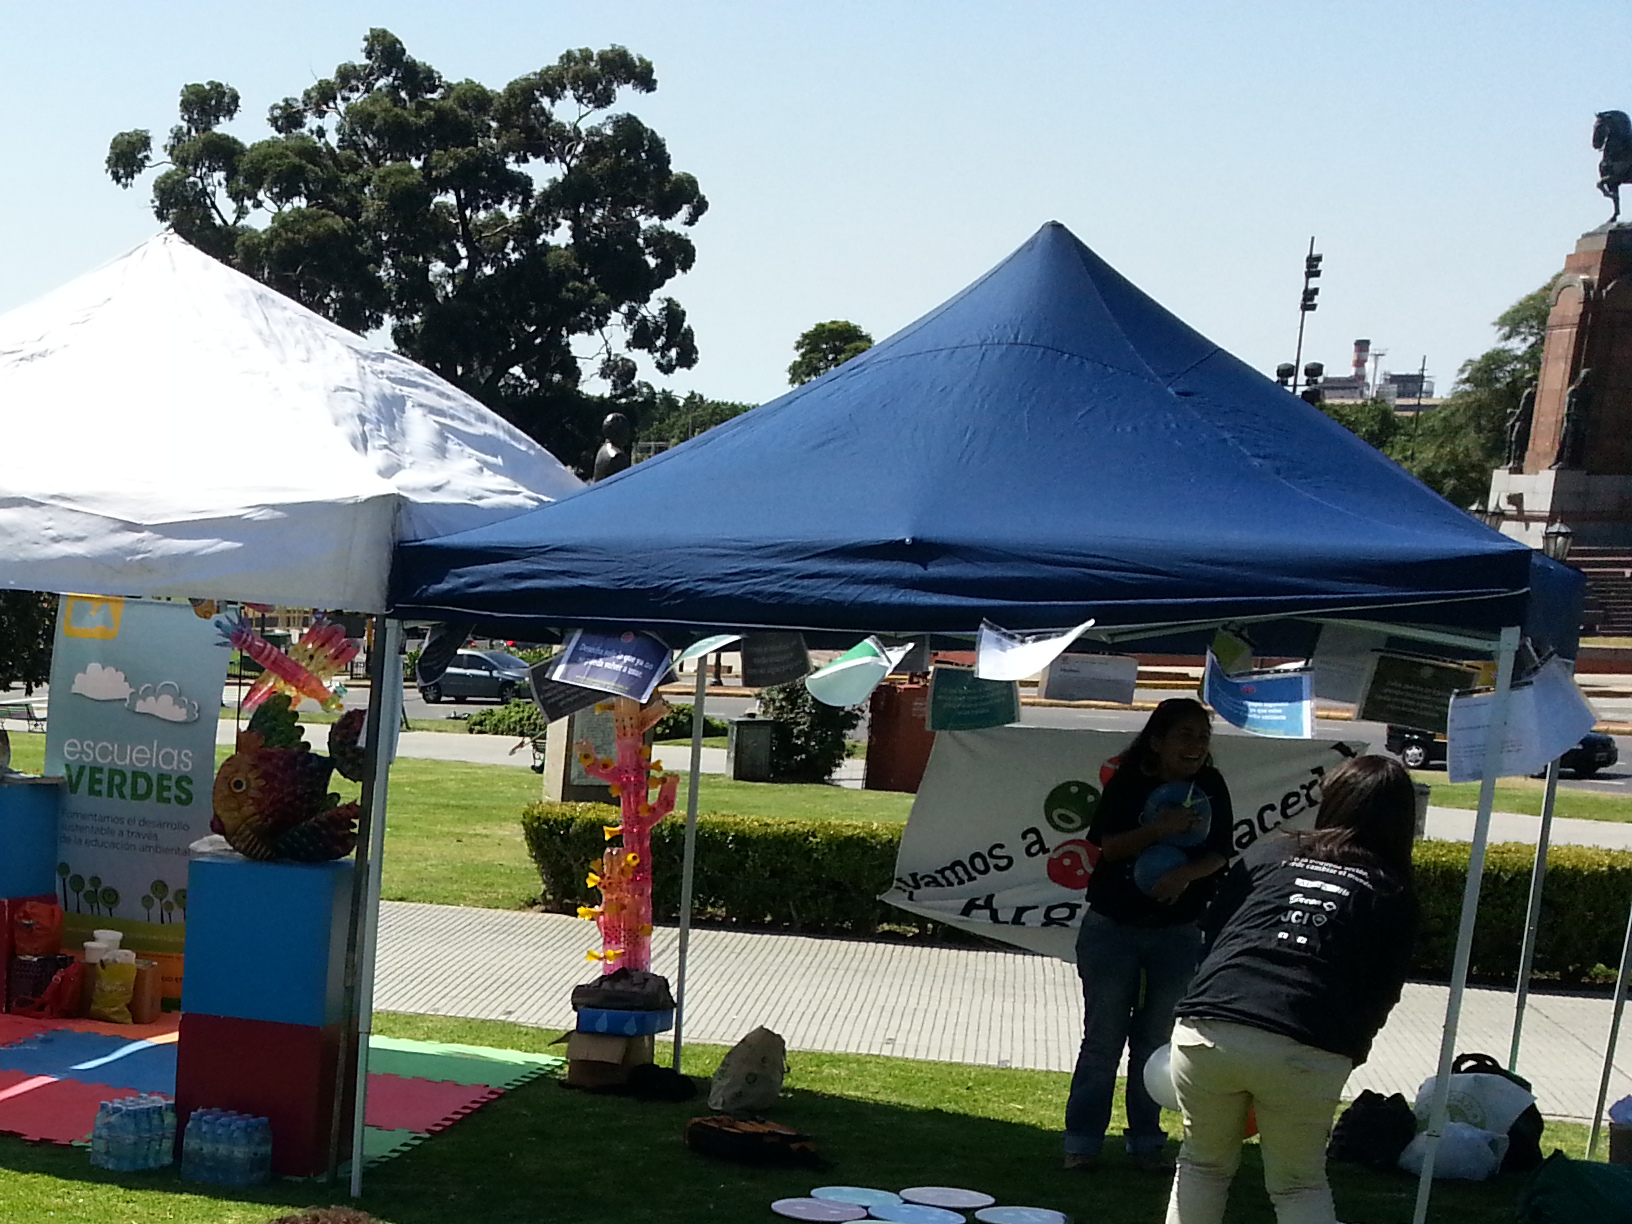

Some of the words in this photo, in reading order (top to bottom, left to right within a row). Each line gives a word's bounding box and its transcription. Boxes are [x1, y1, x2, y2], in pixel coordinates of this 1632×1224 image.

[63, 738, 193, 772] escuelas
[64, 763, 194, 807] VERDES
[138, 817, 190, 832] desarrollo
[84, 837, 136, 851] educación
[1020, 826, 1051, 858] a
[1279, 910, 1310, 925] JCI
